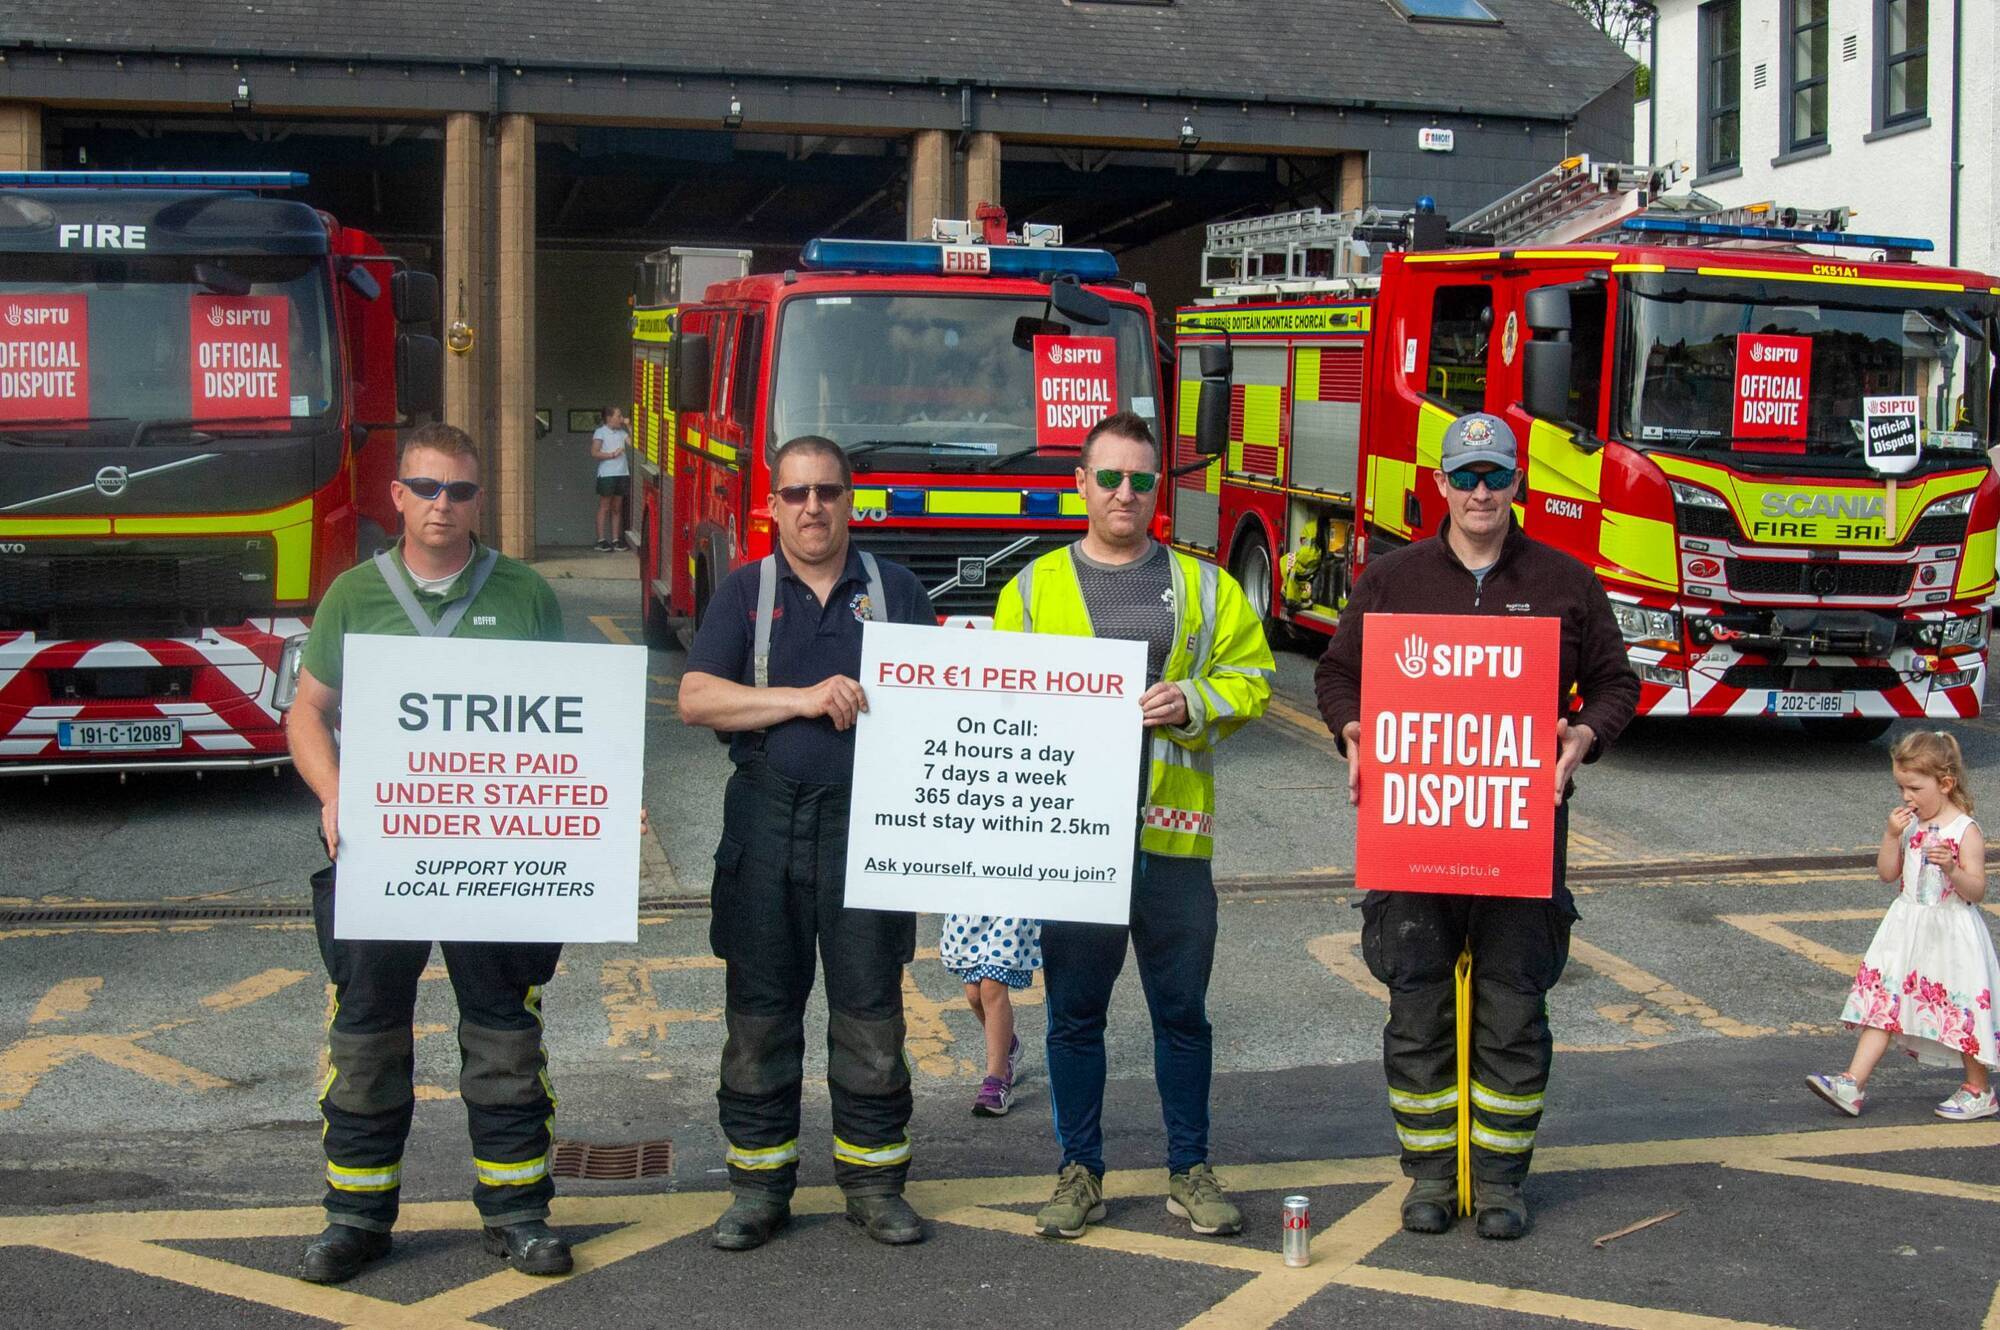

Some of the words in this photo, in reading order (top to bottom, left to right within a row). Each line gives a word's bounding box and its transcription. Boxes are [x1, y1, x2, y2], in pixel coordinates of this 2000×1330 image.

[60, 224, 146, 249] FIRE
[946, 251, 987, 270] FIRE
[1812, 264, 1858, 278] CK51A1
[23, 308, 69, 325] SIPTU
[225, 309, 271, 326] SIPTU
[1232, 313, 1260, 329] DOITEÁIN
[1262, 315, 1292, 329] CHONTAE
[1294, 311, 1326, 328] CHORCAÍ
[199, 342, 282, 368] OFFICIAL
[1064, 348, 1102, 364] SIPTU
[1764, 347, 1798, 363] SIPTU
[1, 371, 76, 398] DISPUTE
[204, 372, 278, 398] DISPUTE
[1042, 377, 1111, 402] OFFICIAL
[1740, 374, 1803, 400] OFFICIAL
[1743, 400, 1799, 426] DISPUTE
[1879, 400, 1915, 414] SIPTU
[1870, 416, 1911, 439] Official
[1873, 432, 1915, 454] Dispute
[1545, 497, 1583, 520] CK51A1
[1760, 491, 1886, 519] SCANIA
[1753, 522, 1817, 538] FIRE
[1432, 644, 1523, 678] SIPTU
[878, 662, 935, 686] FOR
[943, 666, 972, 687] €1
[982, 667, 1037, 691] PER
[1046, 671, 1124, 695] HOUR
[397, 692, 584, 734] STRIKE
[1781, 696, 1842, 711] 202-C-1851
[80, 725, 171, 745] 191-C-12089
[956, 717, 986, 735] On
[993, 718, 1038, 737] Call:
[1375, 711, 1541, 768] OFFICIAL
[408, 751, 506, 774] UNDER
[515, 753, 578, 775] PAID
[924, 740, 948, 756] 24
[954, 741, 1014, 760] hours
[1020, 748, 1032, 761] a
[1038, 744, 1075, 766] day
[923, 764, 936, 780] 7
[941, 765, 990, 785] days
[997, 771, 1008, 783] a
[1015, 770, 1067, 786] week
[375, 782, 474, 805] UNDER
[484, 784, 608, 806] STAFFED
[914, 787, 950, 804] 365
[957, 789, 1005, 810] days
[1012, 796, 1023, 808] a
[1029, 796, 1075, 813] year
[1383, 772, 1530, 830] DISPUTE
[382, 813, 481, 836] UNDER
[490, 815, 601, 837] VALUED
[874, 813, 926, 828] must
[932, 813, 975, 834] stay
[982, 815, 1043, 833] within
[1050, 818, 1111, 836] 2.5km
[414, 860, 508, 876] SUPPORT
[513, 861, 567, 876] YOUR
[864, 857, 897, 872] Ask
[902, 858, 977, 877] yourself,
[982, 862, 1033, 878] would
[1038, 867, 1069, 882] you
[1073, 866, 1117, 882] join?
[1408, 862, 1500, 878] www.siptu.ie
[384, 881, 450, 897] LOCAL
[455, 881, 595, 897] FIREFIGHTERS
